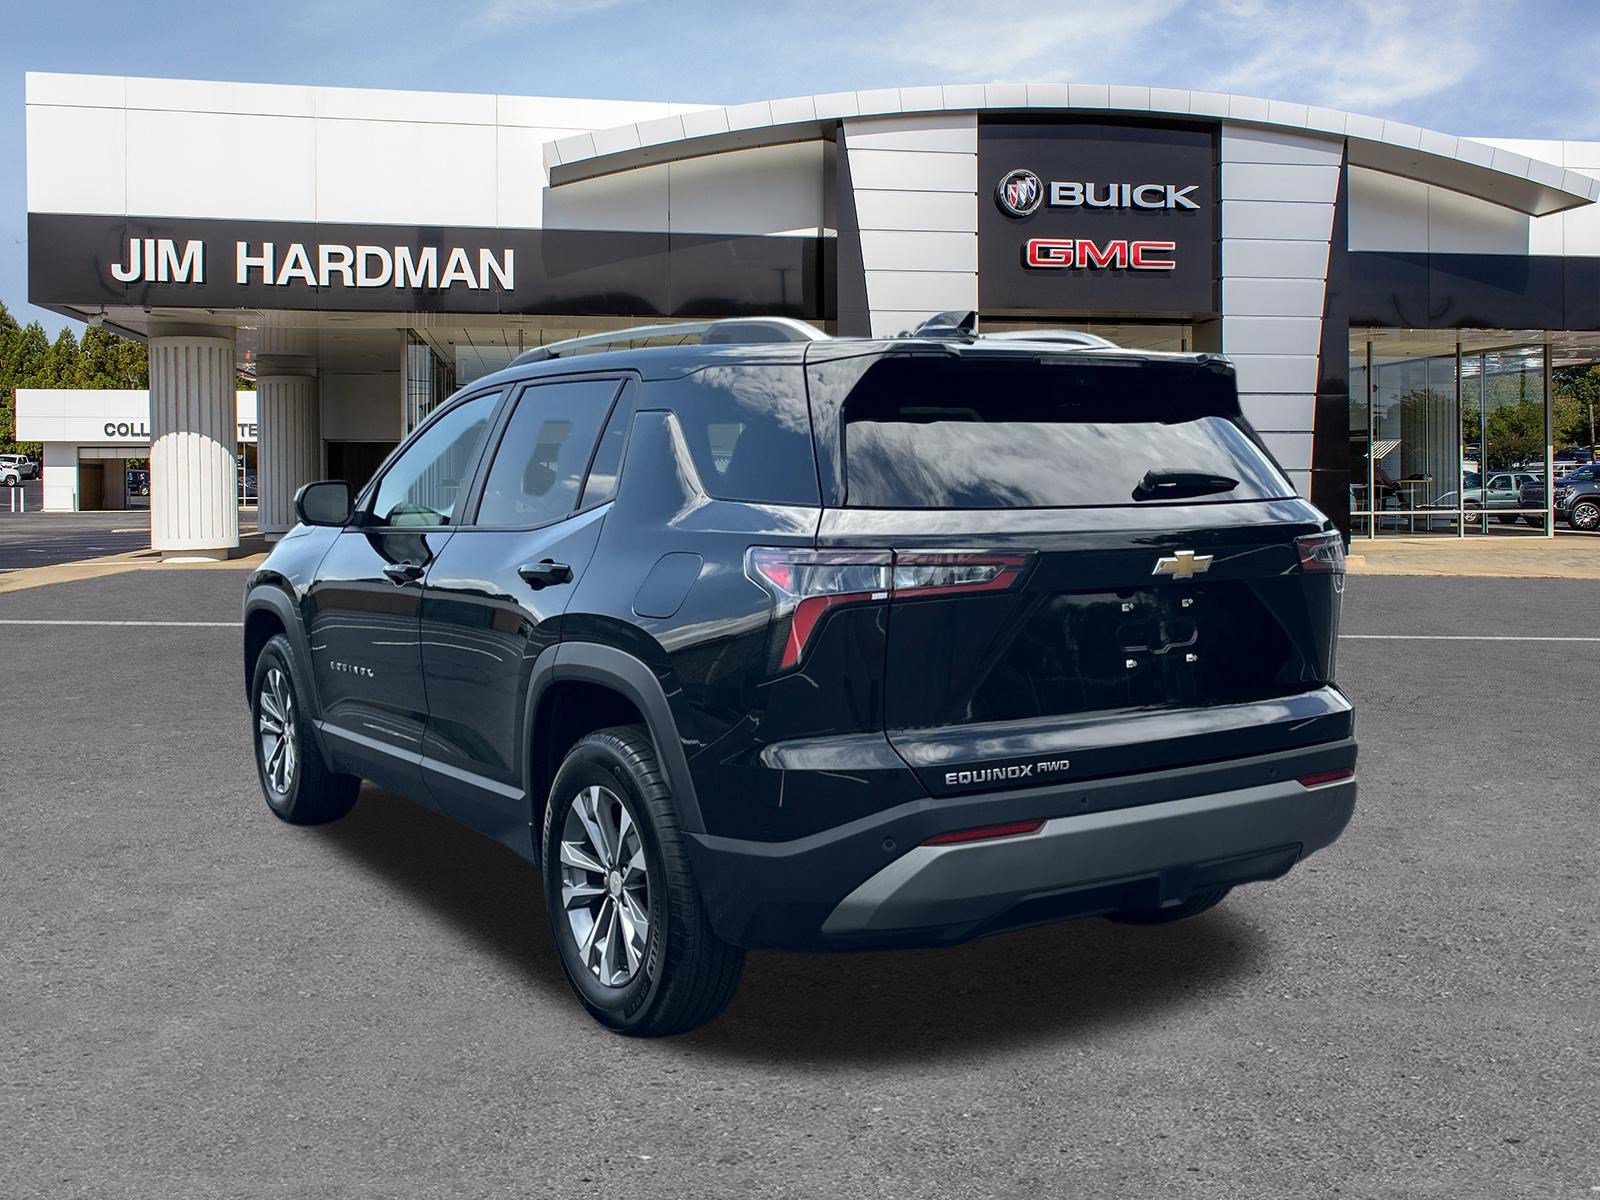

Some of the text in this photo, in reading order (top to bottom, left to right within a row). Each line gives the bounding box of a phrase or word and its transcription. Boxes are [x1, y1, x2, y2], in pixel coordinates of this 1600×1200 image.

[1050, 181, 1200, 209] BUICK
[110, 238, 516, 291] JIM HARDMAN
[1026, 238, 1177, 270] GMC
[945, 760, 1071, 785] EQUINOX AWD
